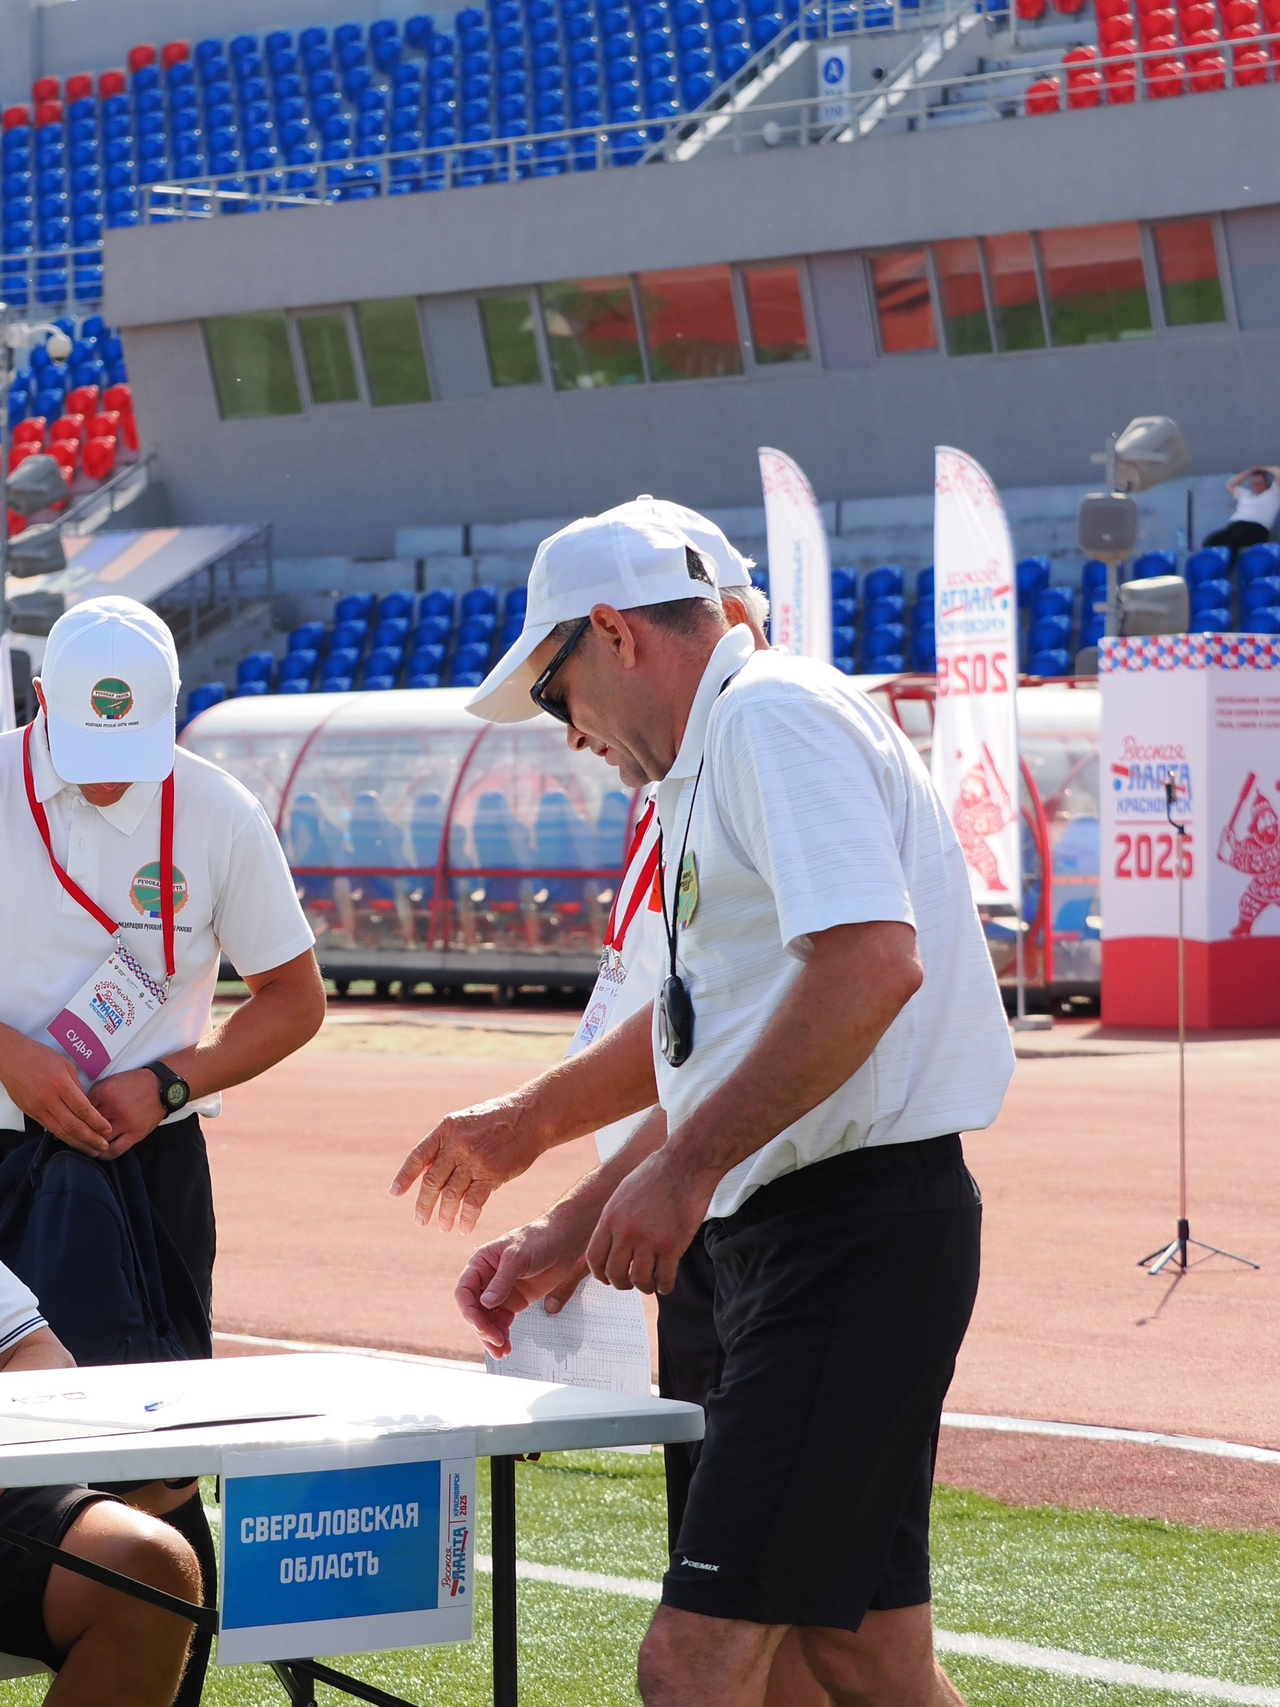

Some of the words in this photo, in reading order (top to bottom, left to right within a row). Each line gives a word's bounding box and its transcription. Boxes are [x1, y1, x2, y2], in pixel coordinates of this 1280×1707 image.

[1114, 833, 1193, 879] 2025
[66, 1029, 93, 1059] СУДЬЯ
[240, 1502, 419, 1544] СВЕРДЛОВСКАЯ
[280, 1550, 379, 1584] ОБЛАСТЬ
[452, 1526, 467, 1581] ЛАПТА
[687, 1560, 720, 1571] DEMIX
